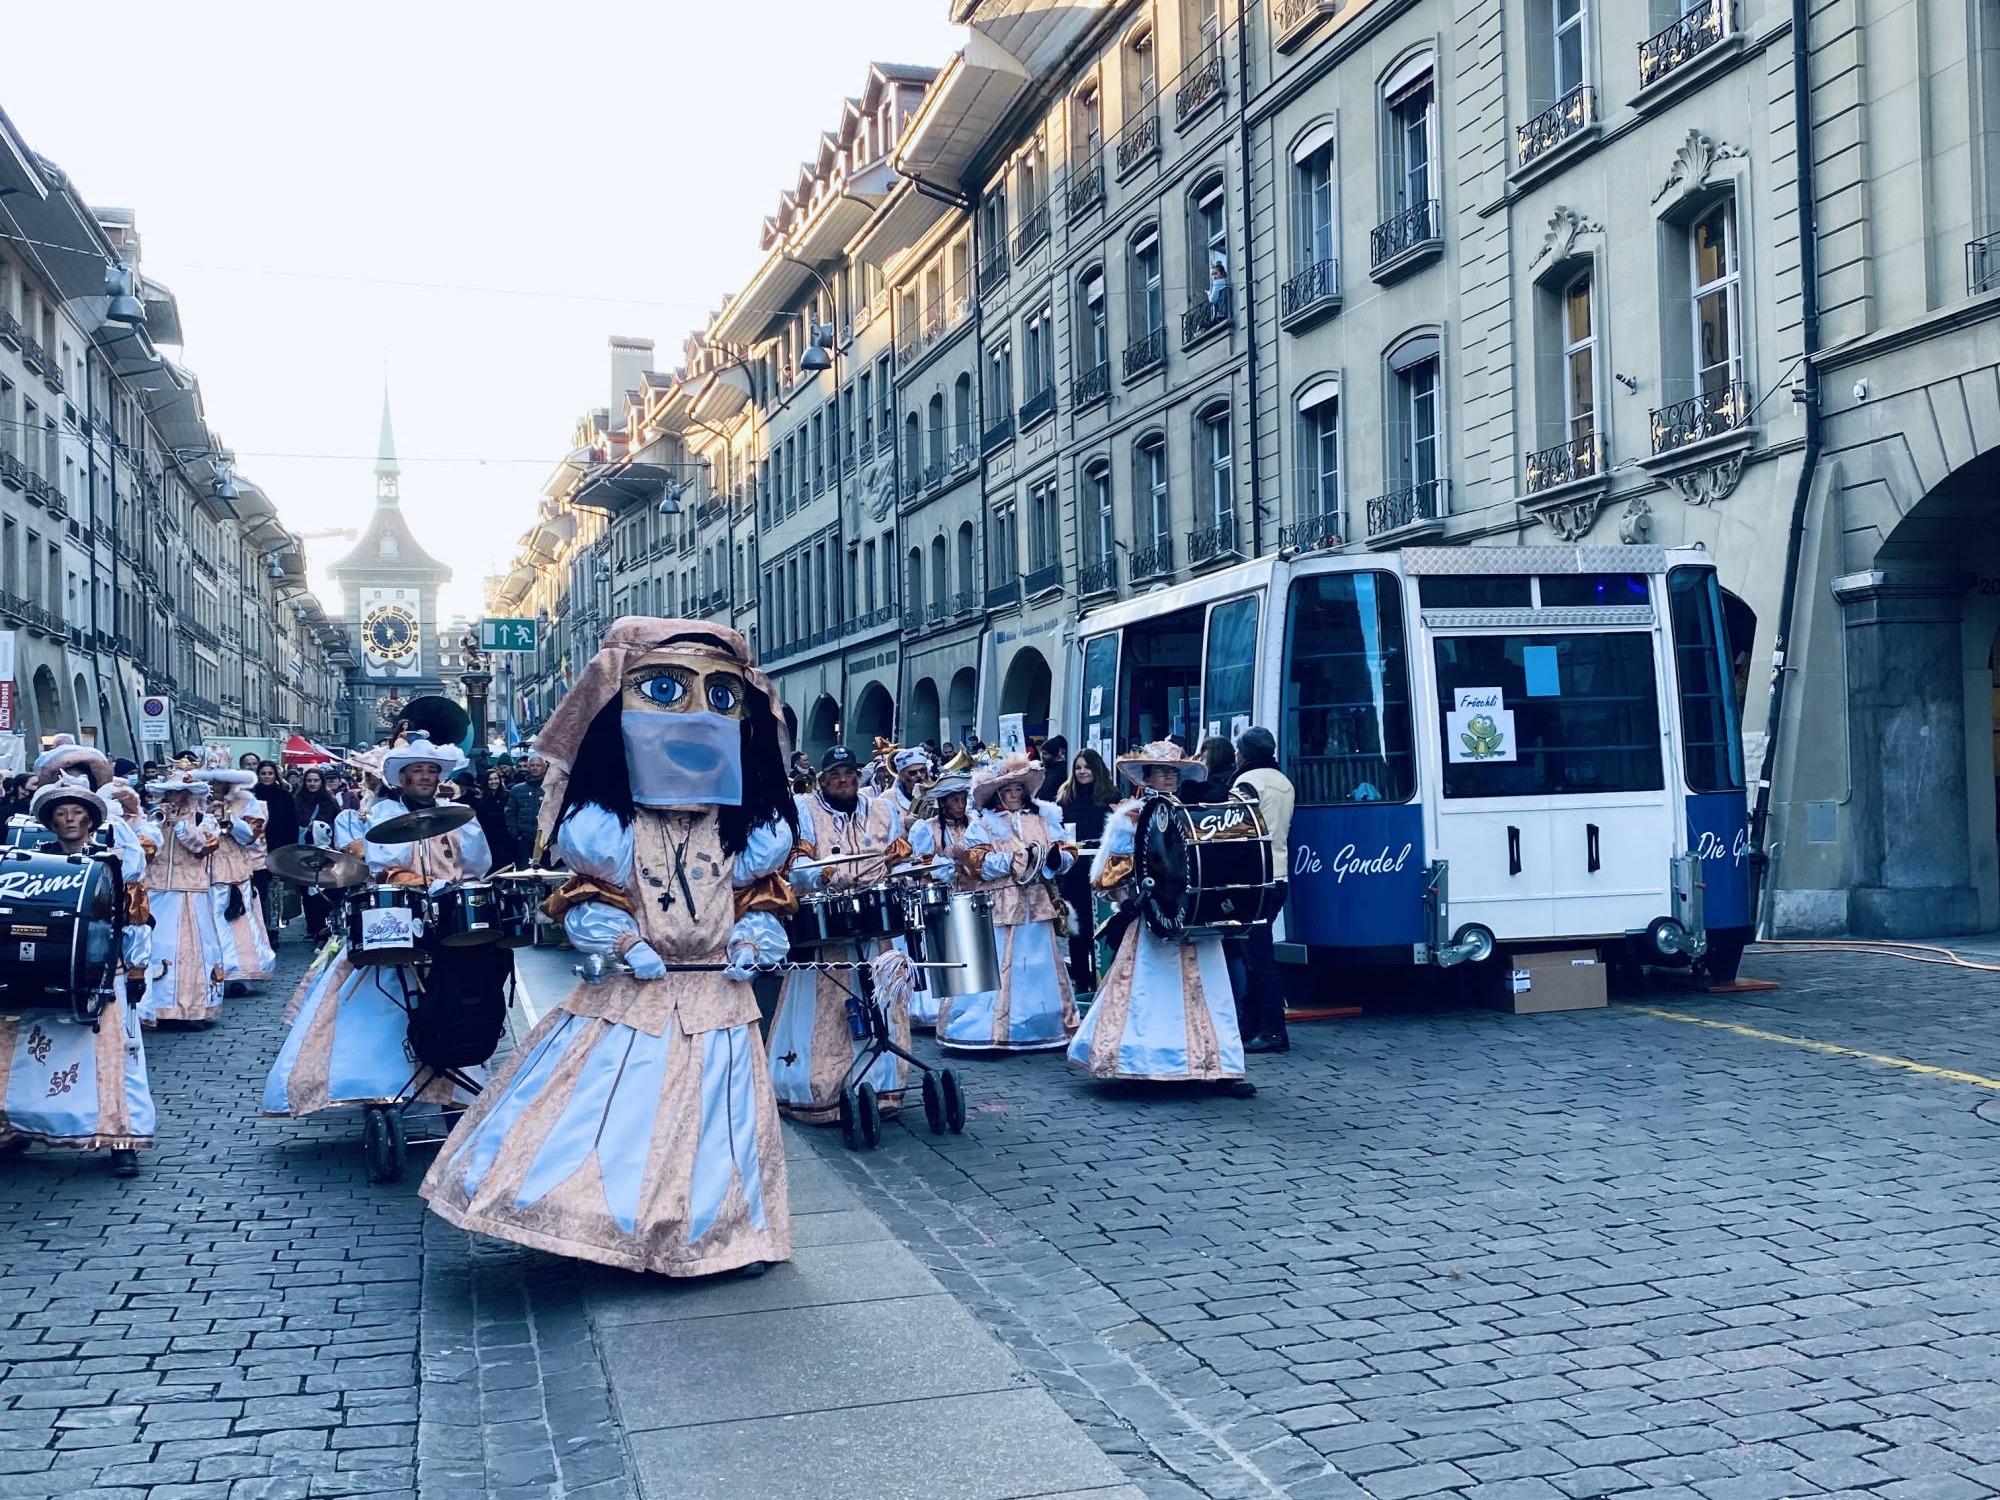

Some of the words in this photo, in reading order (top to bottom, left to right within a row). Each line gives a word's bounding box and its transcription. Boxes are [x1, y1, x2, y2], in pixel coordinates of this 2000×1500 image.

[1460, 694, 1500, 708] Fröschli
[1199, 808, 1245, 841] Silä
[1697, 831, 1726, 860] Die
[1294, 845, 1323, 875] Die
[1333, 843, 1412, 884] Gondel
[0, 869, 86, 900] Rämi
